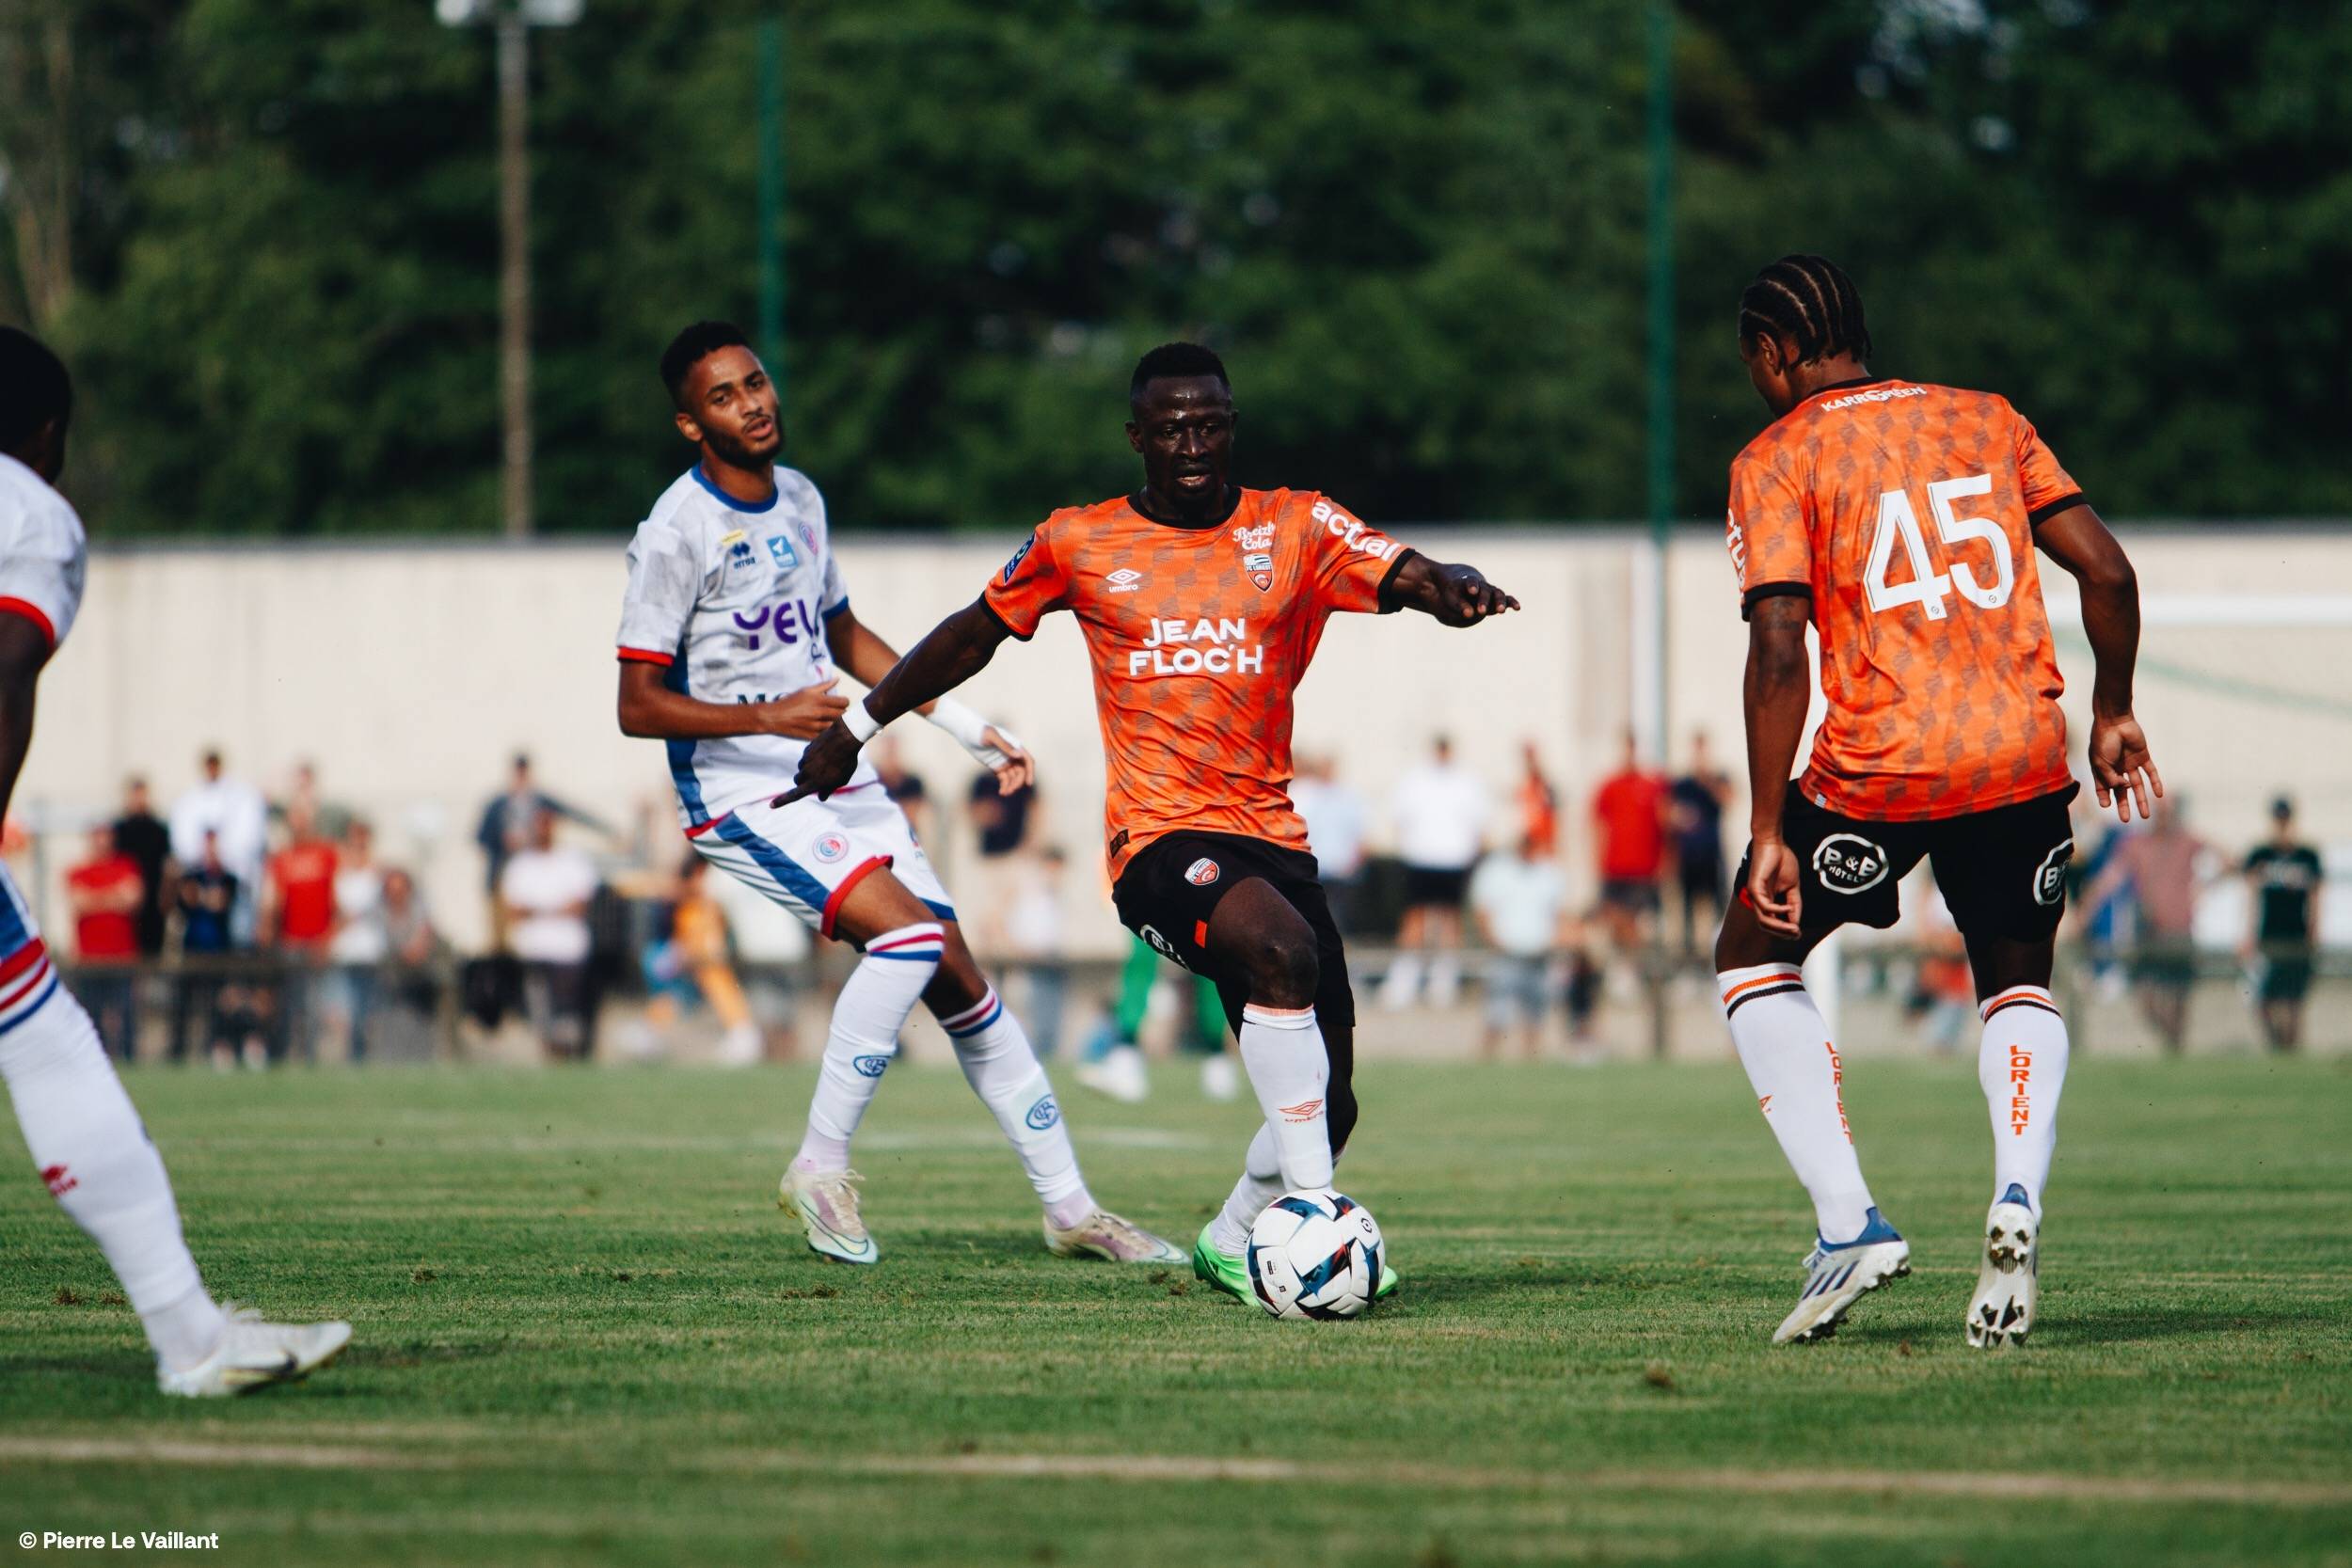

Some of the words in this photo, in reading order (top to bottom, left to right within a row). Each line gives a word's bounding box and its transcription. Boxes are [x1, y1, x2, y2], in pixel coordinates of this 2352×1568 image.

[1242, 537, 1273, 550] Cola
[1311, 501, 1400, 562] actual
[1863, 473, 2014, 621] 45
[1109, 583, 1138, 594] umbro
[1143, 618, 1246, 647] JEAN
[1129, 644, 1263, 676] FLOC'H
[1823, 847, 1879, 877] B&B
[2010, 1045, 2032, 1135] LORIENT
